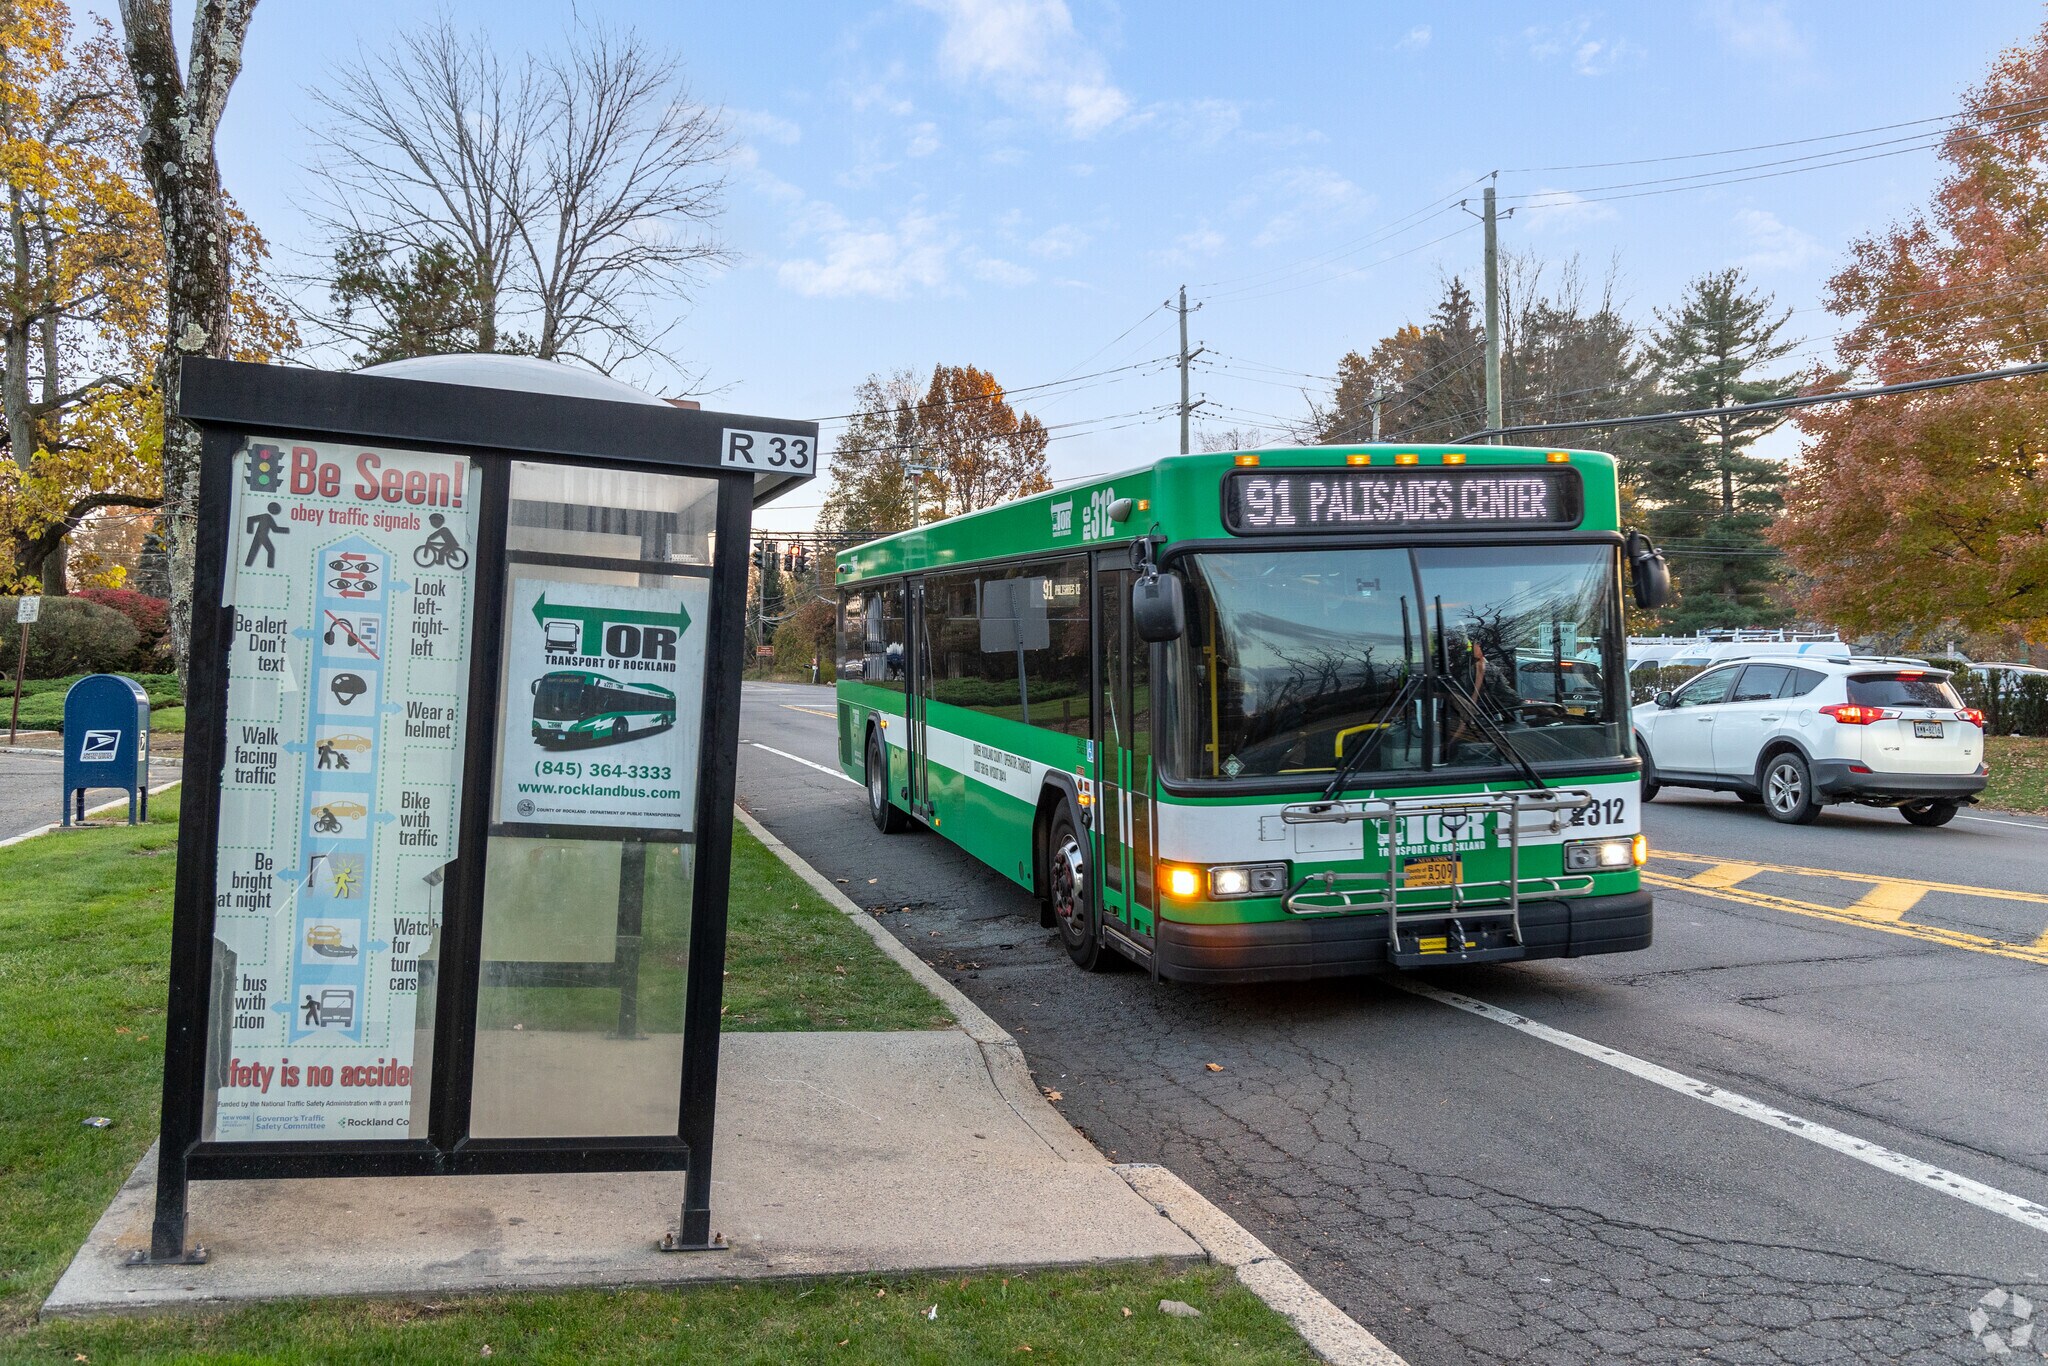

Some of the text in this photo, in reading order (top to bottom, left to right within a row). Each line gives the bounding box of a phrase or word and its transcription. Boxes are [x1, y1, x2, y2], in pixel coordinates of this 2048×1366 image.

[728, 433, 809, 468] R 33
[289, 446, 463, 508] Be Seen!
[1246, 479, 1547, 525] 91 PALISADES CENTER
[290, 504, 421, 532] obey traffic signals
[1091, 487, 1115, 540] 312
[414, 577, 446, 597] Look
[1043, 580, 1054, 600] 91
[413, 597, 442, 615] left-
[235, 614, 287, 634] Be alert
[412, 615, 449, 639] right-
[249, 634, 286, 654] Don't
[410, 638, 434, 657] left
[258, 656, 285, 672] text
[544, 655, 677, 673] TRANSPORT OF ROCKLAND
[406, 701, 454, 721] Wear a
[242, 725, 279, 745] Walk
[404, 719, 451, 739] helmet
[235, 746, 277, 768] facing
[235, 767, 276, 785] traffic
[534, 760, 672, 780] (845) 364-3333
[401, 791, 431, 810] Bike
[518, 783, 681, 800] www.rocklandbus.com
[400, 810, 430, 828] with
[1588, 798, 1624, 826] 312
[399, 828, 438, 847] traffic
[1378, 845, 1428, 857] TRNSPORT
[1430, 843, 1441, 853] OF
[255, 852, 273, 870] Be
[232, 871, 272, 893] bright
[217, 890, 271, 912] at night
[392, 937, 410, 954] for
[243, 974, 267, 991] bus
[389, 977, 417, 991] cars
[235, 993, 266, 1010] with
[281, 1058, 300, 1087] is
[306, 1065, 334, 1087] no
[256, 1123, 282, 1131] Safety
[283, 1122, 326, 1130] Committee
[301, 1114, 325, 1122] Traffic
[347, 1118, 410, 1126] Rockland Co
